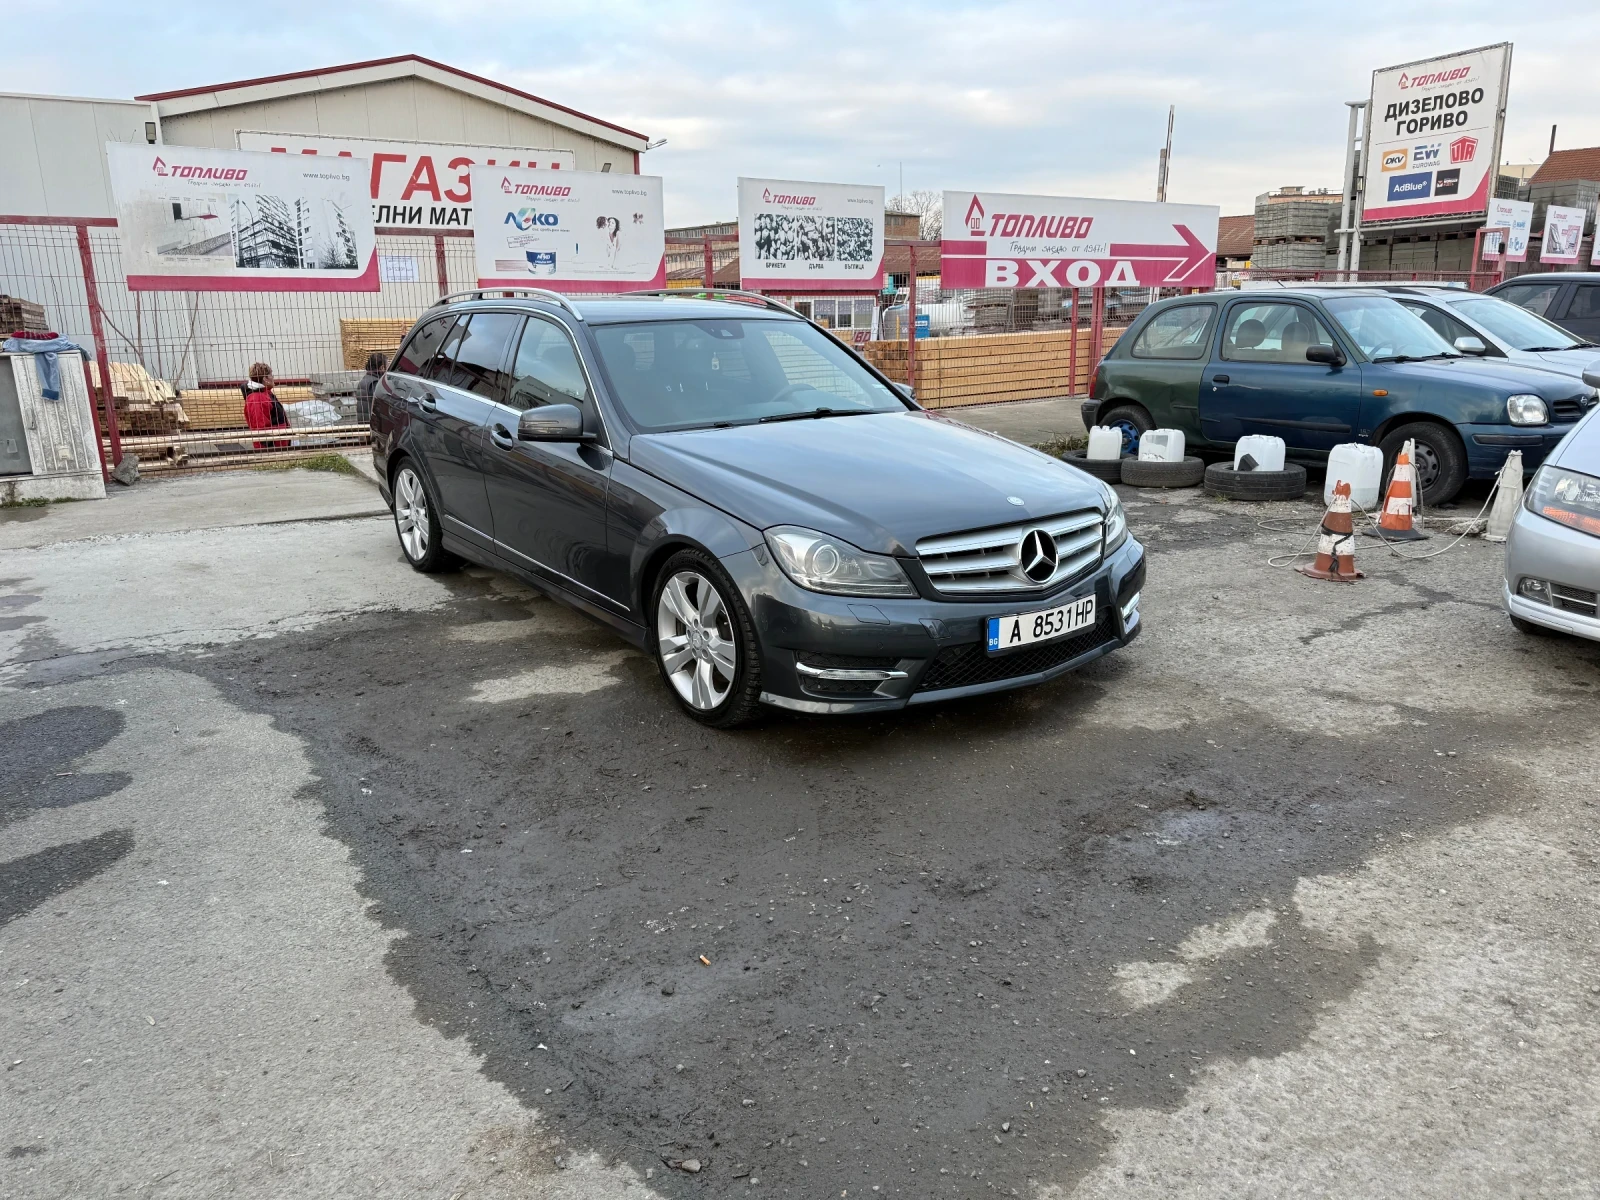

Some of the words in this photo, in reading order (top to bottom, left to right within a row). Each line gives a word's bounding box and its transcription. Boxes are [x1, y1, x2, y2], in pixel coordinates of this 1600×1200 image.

[1384, 87, 1484, 122] ДИЗЕЛОВО
[1396, 110, 1468, 136] ГОРИВО
[1385, 155, 1404, 165] DKV
[1450, 136, 1478, 163] UTA
[171, 165, 248, 181] ТОПЛИВО
[514, 184, 572, 197] ТОПЛИВО
[772, 194, 816, 206] ТОПЛИВО
[372, 205, 423, 225] ЛНИ
[429, 206, 472, 226] МАТ
[989, 213, 1094, 239] ТОПЛИВО
[984, 259, 1140, 288] ВХОД
[989, 637, 999, 646] BG
[1010, 619, 1021, 643] A
